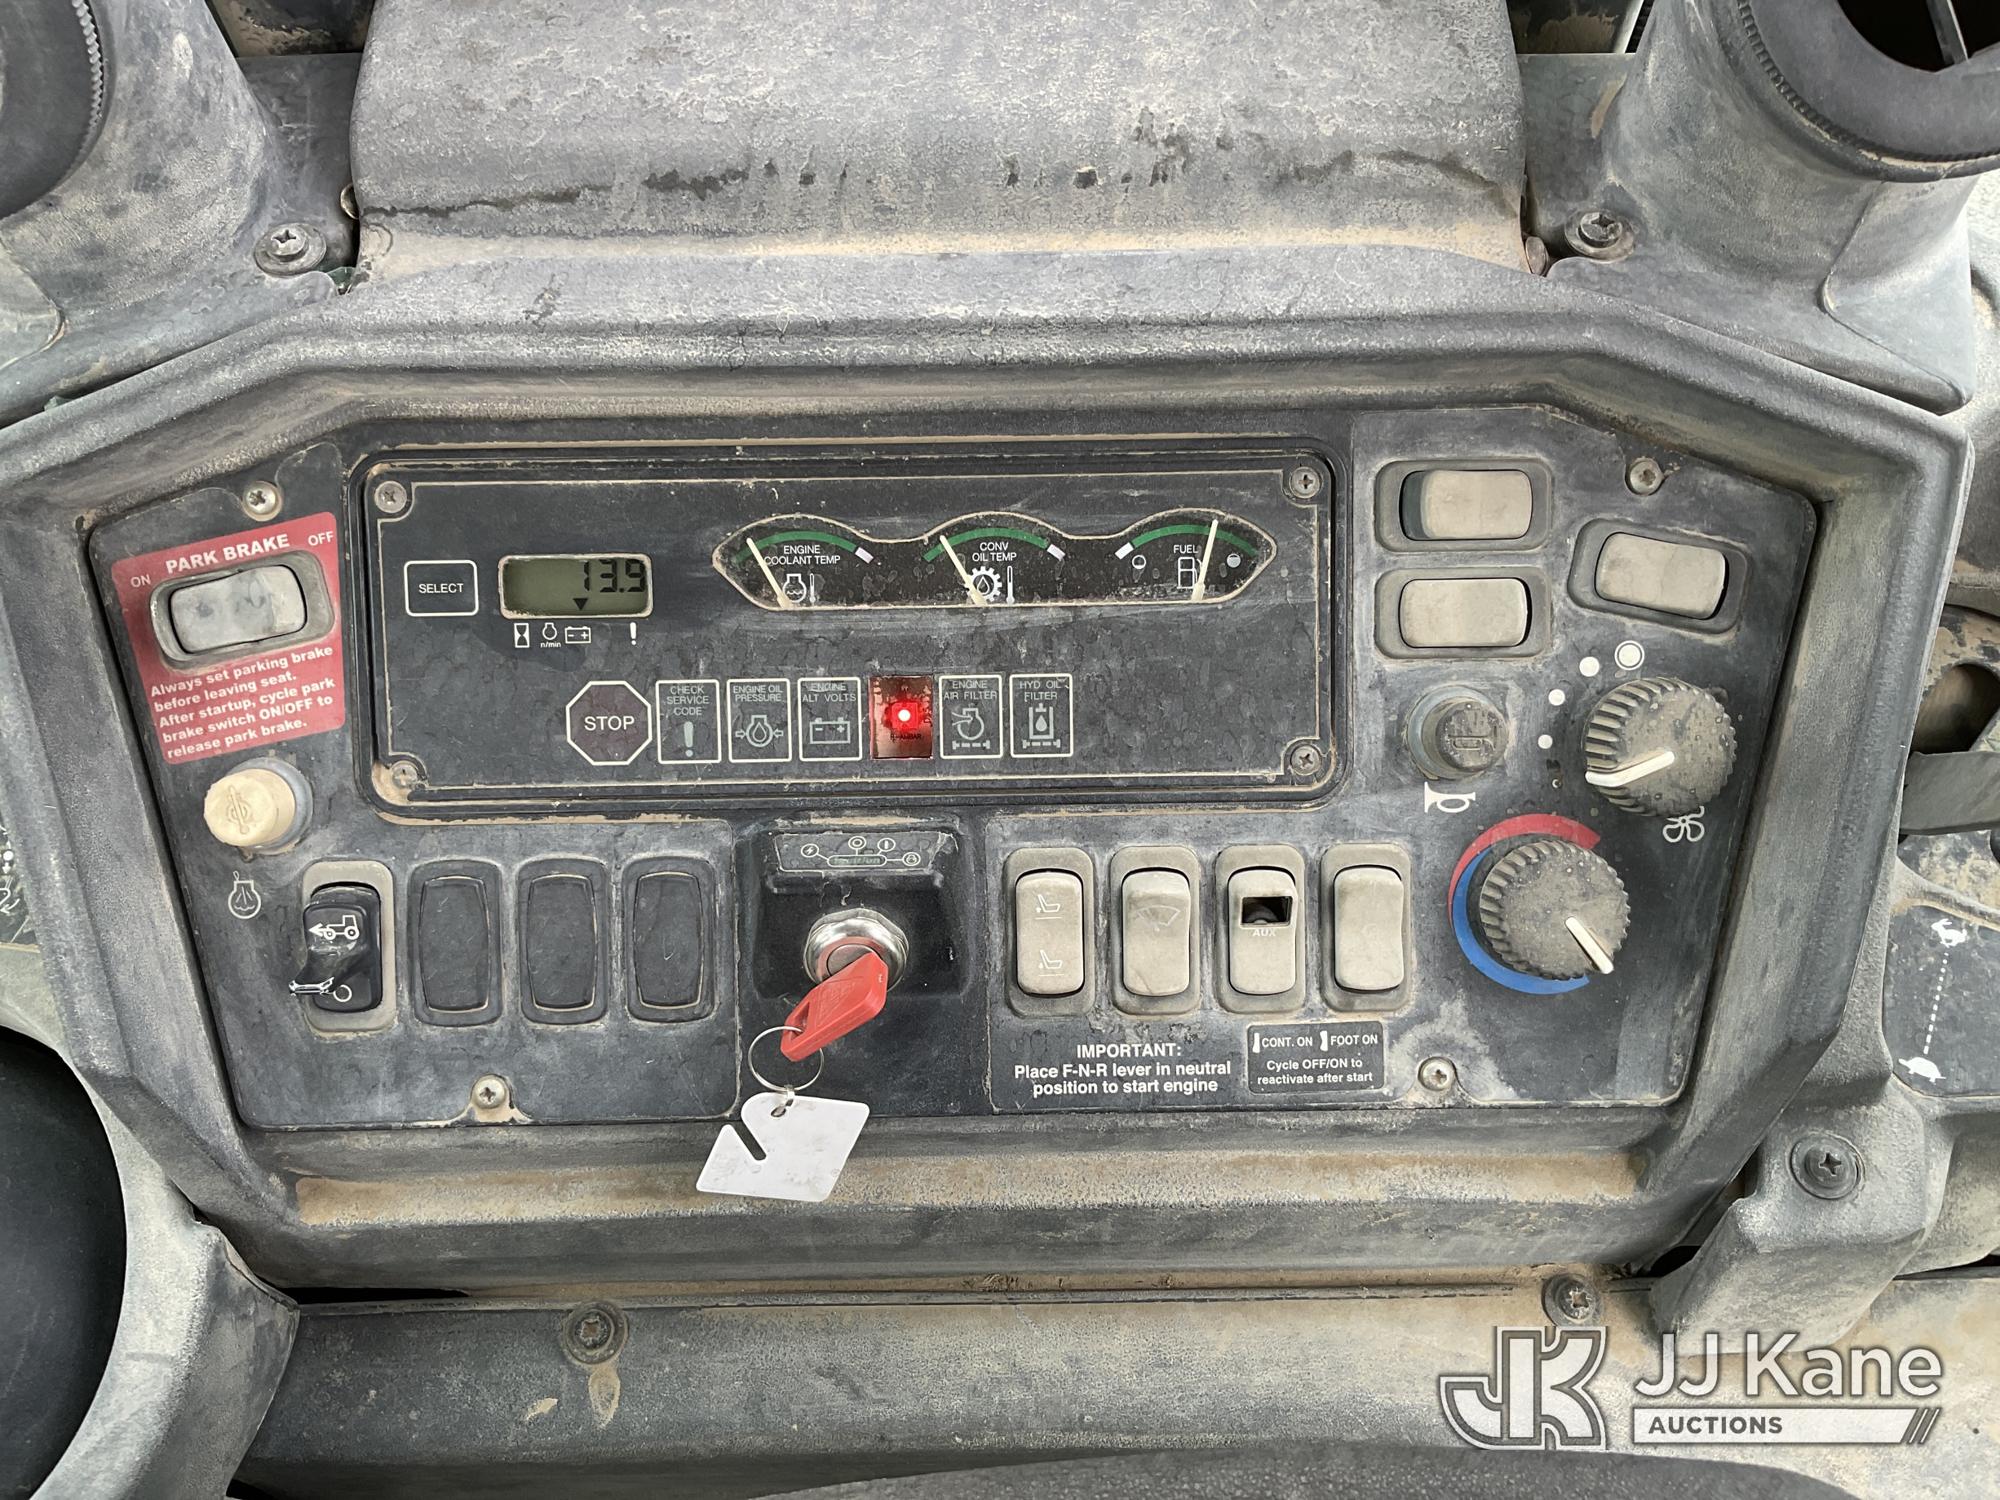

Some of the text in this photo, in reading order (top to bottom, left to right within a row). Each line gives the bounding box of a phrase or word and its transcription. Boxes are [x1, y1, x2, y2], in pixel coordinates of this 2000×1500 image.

[308, 531, 334, 547] OFF
[784, 545, 820, 555] ENGINE
[980, 542, 1009, 552] CONV
[1174, 545, 1200, 554] FUEL
[166, 534, 290, 574] PARK BRAKE
[972, 552, 1017, 562] OIL TEMP
[765, 555, 842, 566] COOLANT TEMP
[130, 574, 152, 588] ON
[583, 558, 646, 594] 13.9
[418, 583, 464, 594] SELECT
[540, 641, 562, 649] n/min
[152, 646, 333, 698] Always set parking brake
[733, 685, 784, 694] ENGINE OIL
[810, 684, 846, 692] ENGINE
[952, 680, 988, 689] ENGINE
[1020, 680, 1062, 690] HYD OIL
[154, 671, 297, 712] before leaving seat.
[670, 686, 705, 695] CHECK
[944, 690, 998, 700] AIR FILTER
[1024, 692, 1058, 700] FILTER
[159, 677, 336, 728] After startup, cycle park
[667, 696, 710, 705] SERVICE
[735, 694, 782, 702] PRESSURE
[802, 694, 856, 702] ALT VOLTS
[674, 707, 702, 716] CODE
[162, 696, 333, 744] brake switch ON/OFF to
[584, 716, 636, 732] STOP
[168, 719, 308, 758] release park brake.
[1252, 928, 1276, 938] AUX
[1262, 1037, 1313, 1048] CONT. ON
[1330, 1034, 1378, 1046] FOOT ON
[1077, 1042, 1182, 1058] IMPORTANT:
[1014, 1061, 1232, 1078] Place F-N-R lever in neutral
[1266, 1058, 1362, 1072] Cycle OFF/ON to
[1258, 1072, 1373, 1085] reactivate after start
[1033, 1078, 1218, 1098] position to start engine
